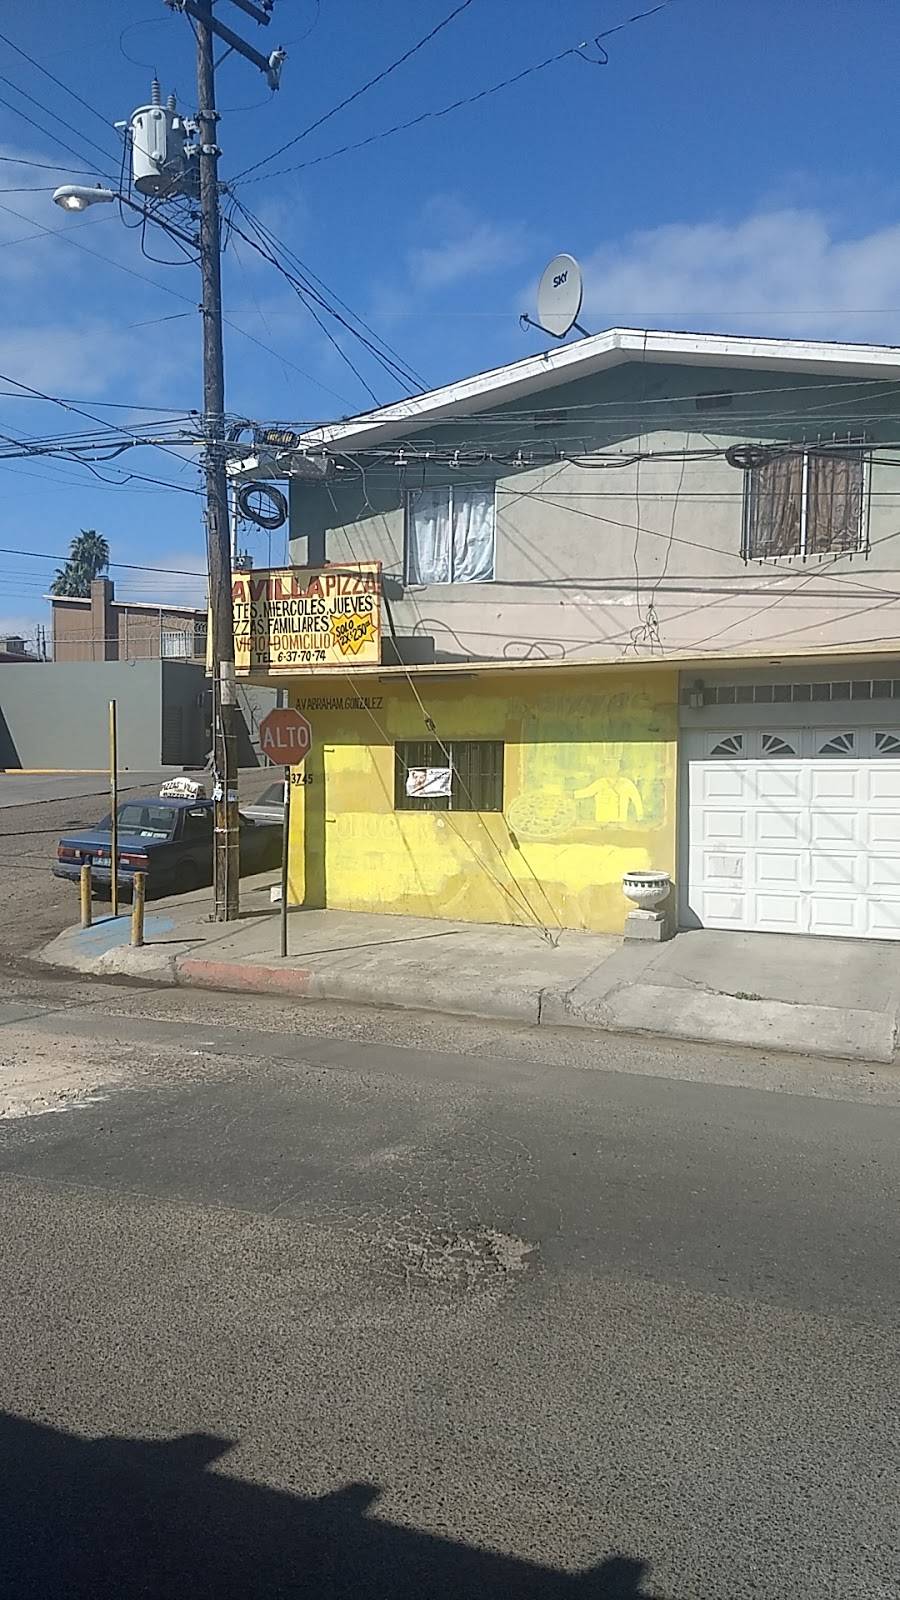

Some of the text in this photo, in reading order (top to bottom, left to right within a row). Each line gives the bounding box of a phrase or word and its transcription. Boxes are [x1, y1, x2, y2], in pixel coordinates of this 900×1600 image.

[553, 270, 568, 288] SKY
[326, 572, 376, 596] PIZZA
[329, 595, 373, 614] JUEVES
[268, 616, 330, 635] FAMILIARES
[336, 620, 354, 637] SOLO
[273, 633, 331, 651] DOMICILIO
[263, 726, 308, 748] ALTO
[291, 773, 313, 785] 3745
